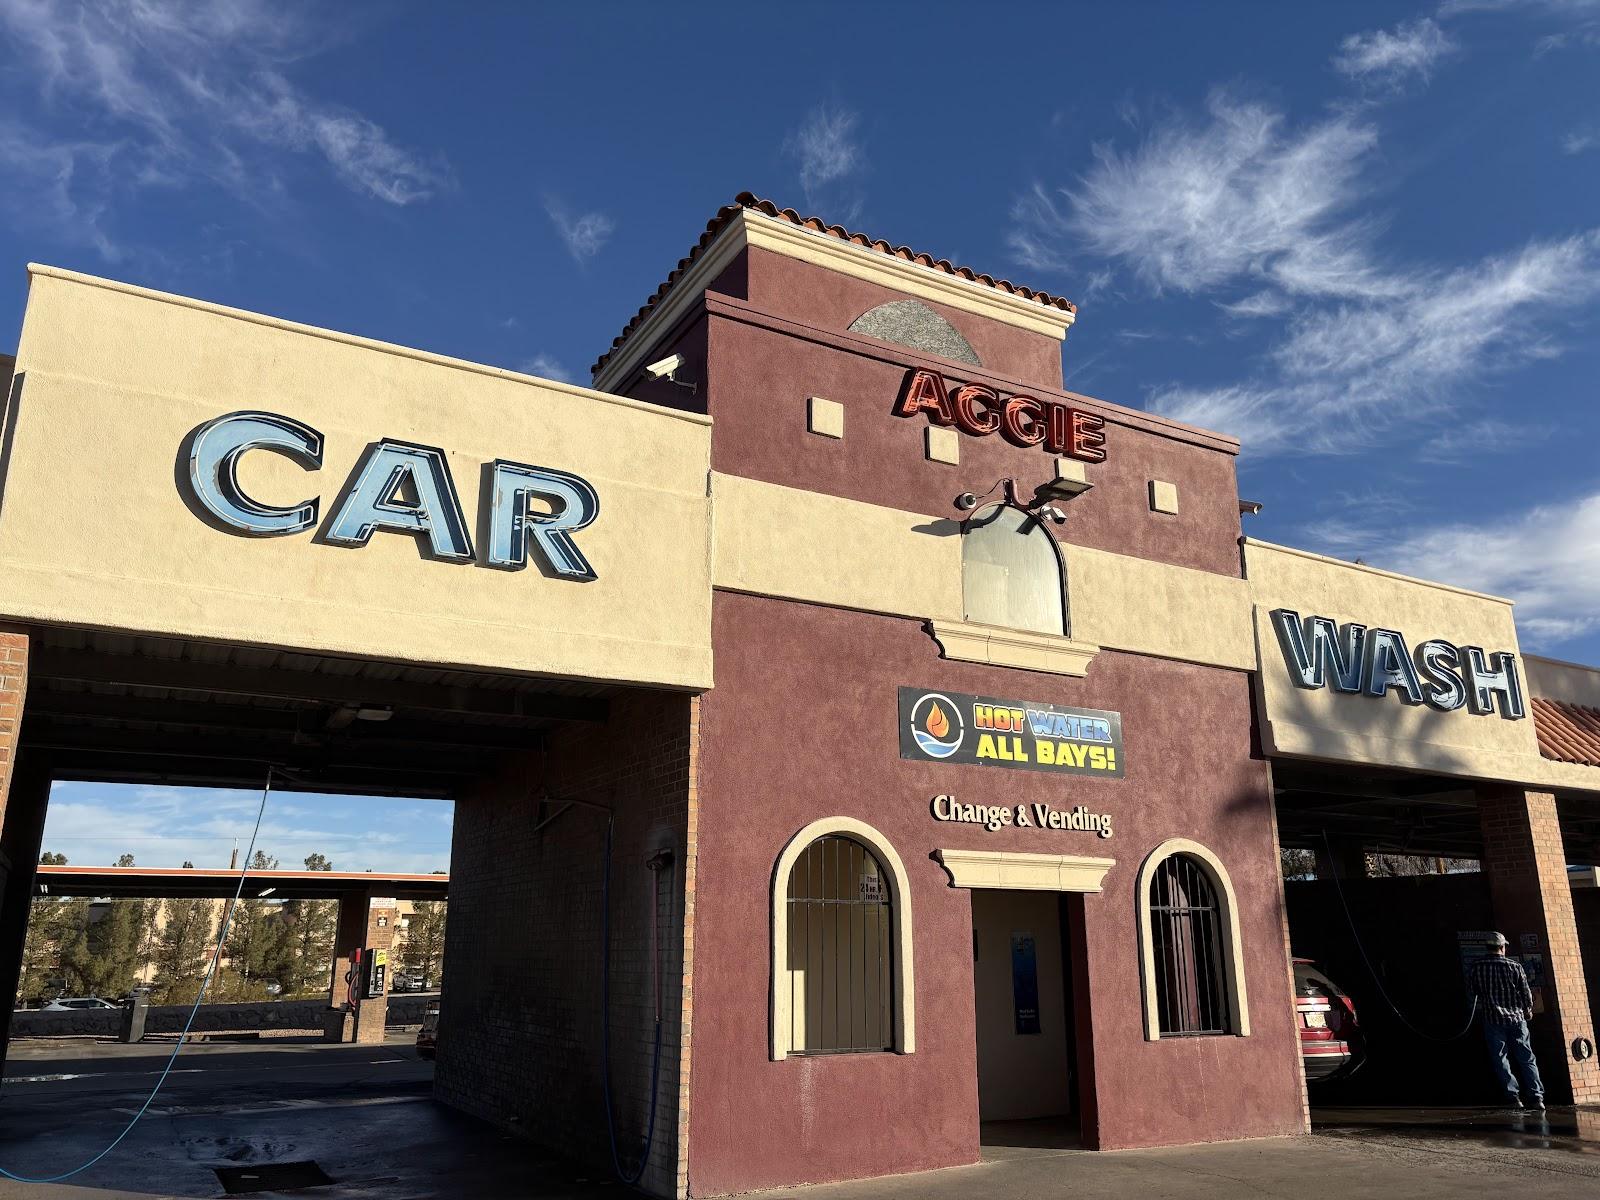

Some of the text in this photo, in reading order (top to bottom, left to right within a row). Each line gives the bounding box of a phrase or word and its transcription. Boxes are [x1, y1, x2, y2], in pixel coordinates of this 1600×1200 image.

[891, 366, 1107, 464] AGGIE
[174, 409, 600, 583] CAR
[1269, 608, 1526, 720] WASH
[973, 703, 1112, 743] HOT WATER
[976, 733, 1116, 771] ALL BAYS!
[930, 794, 1114, 838] Change & Vending
